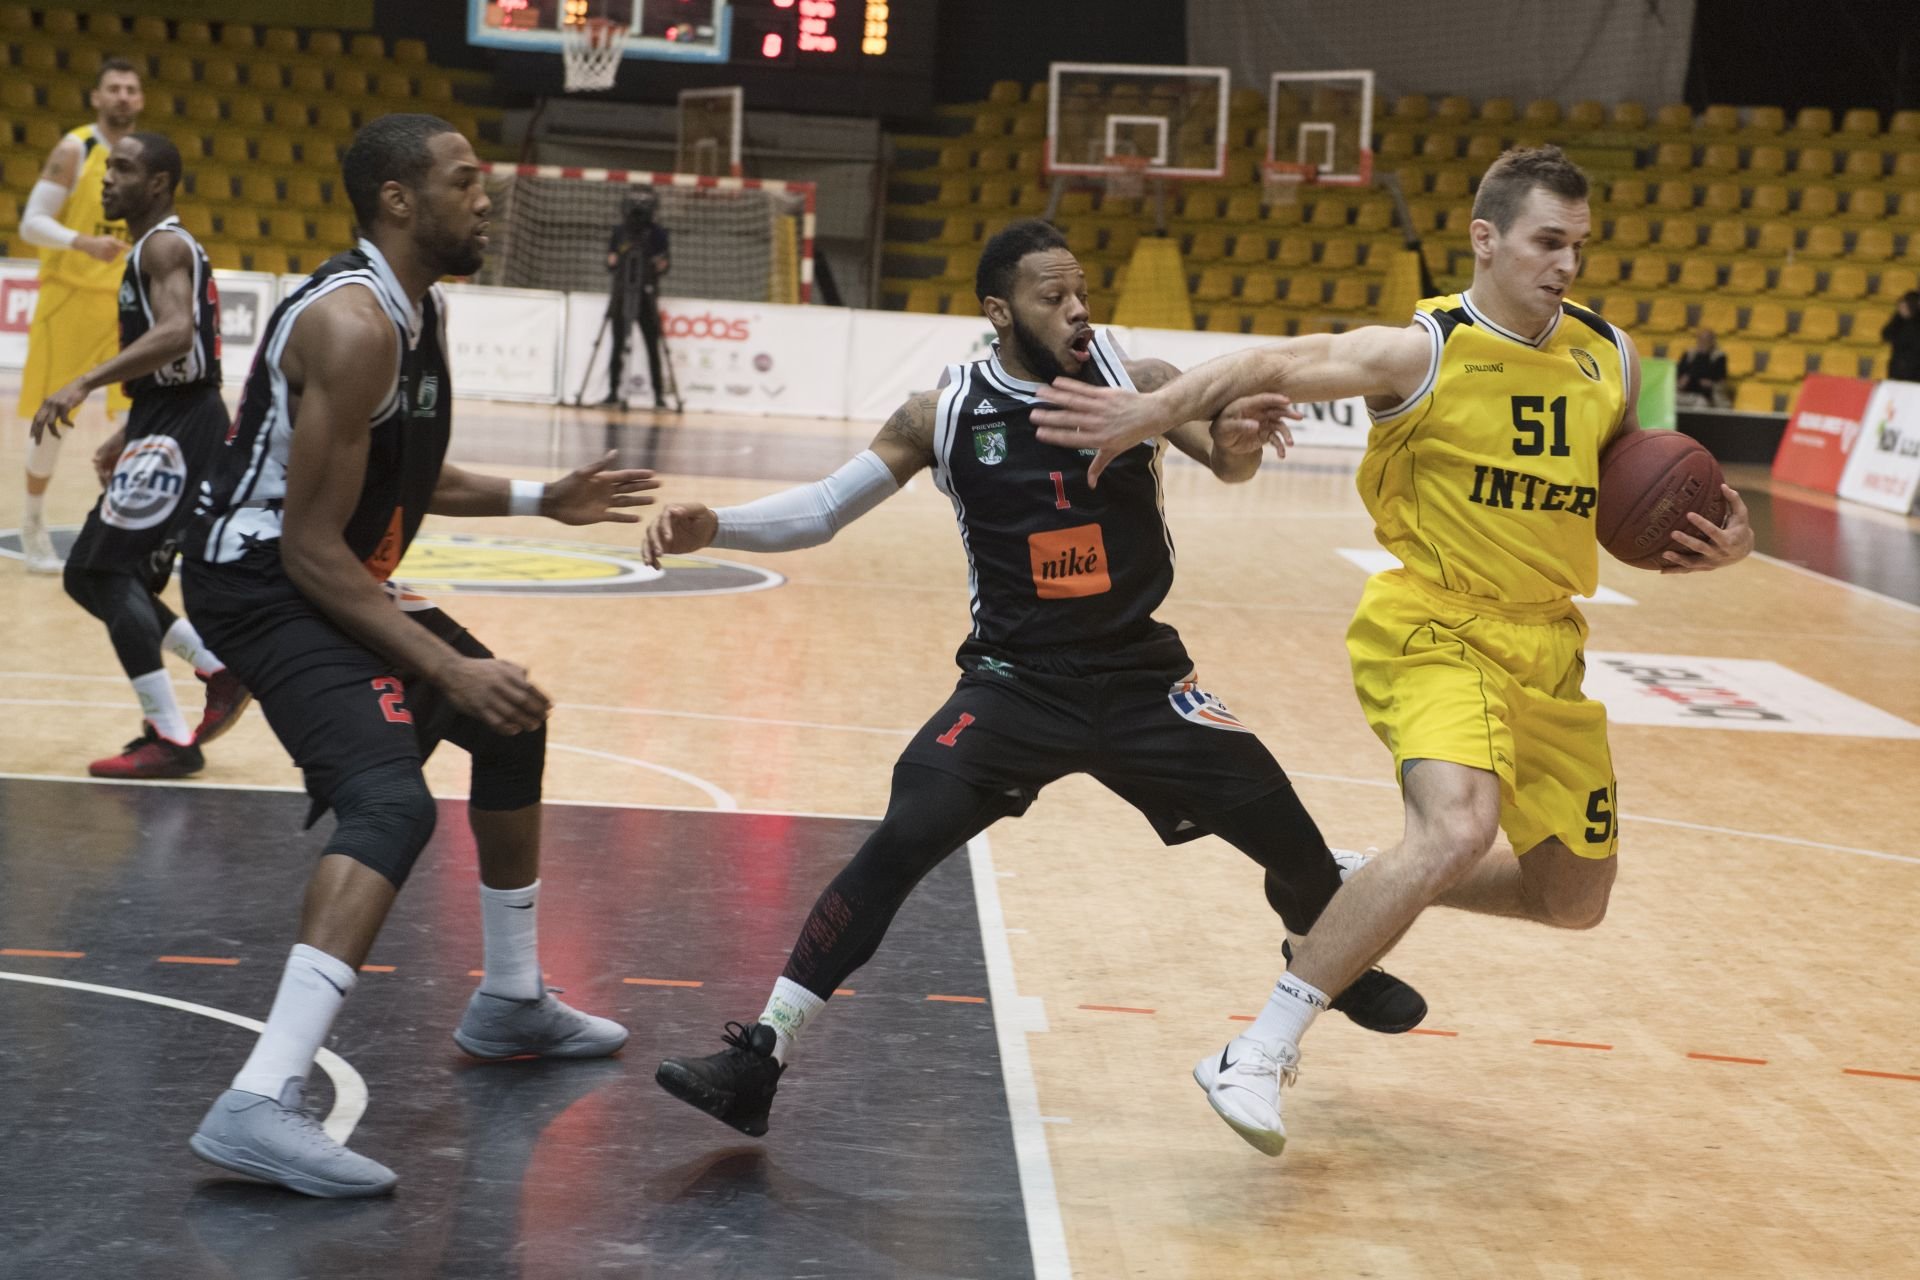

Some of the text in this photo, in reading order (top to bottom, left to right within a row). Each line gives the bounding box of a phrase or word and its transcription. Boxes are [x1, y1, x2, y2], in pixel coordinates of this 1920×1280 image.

[1464, 363, 1504, 374] SPALDING
[971, 421, 1007, 432] PRIEVIDZA
[973, 407, 998, 416] PEAK
[1510, 395, 1571, 457] 51
[1049, 471, 1072, 510] 1
[1469, 464, 1598, 519] INTER
[1041, 546, 1098, 580] niké
[371, 676, 413, 724] 2
[936, 712, 976, 747] 1
